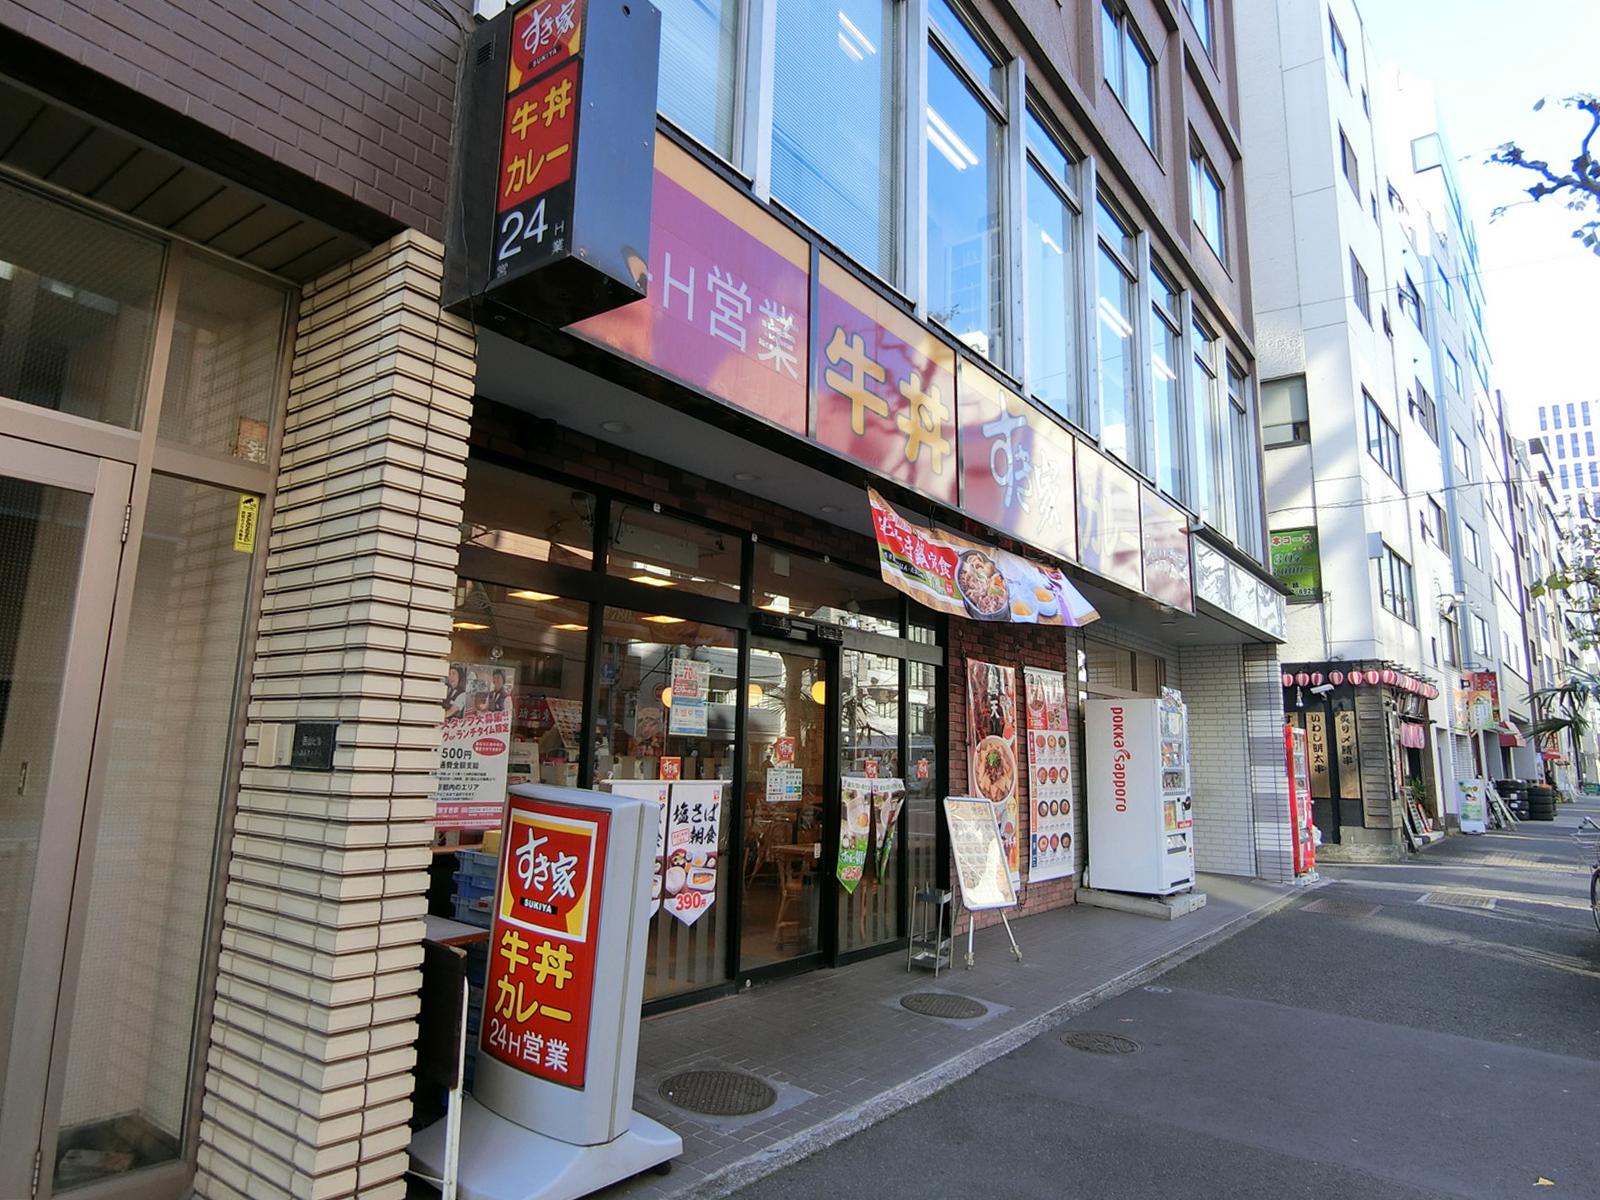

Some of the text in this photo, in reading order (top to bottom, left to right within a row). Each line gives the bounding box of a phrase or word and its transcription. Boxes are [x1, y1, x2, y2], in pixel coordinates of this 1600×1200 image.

[521, 0, 576, 55] すき家
[531, 48, 558, 68] SUKIYA
[510, 78, 573, 141] 牛丼
[503, 142, 570, 198] カレー
[824, 325, 952, 477] 牛丼
[982, 388, 1062, 536] すき家
[1310, 714, 1325, 774] いわし明太串
[688, 825, 717, 846] 朝食
[515, 827, 579, 902] すき家
[523, 898, 553, 914] SUKIYA
[675, 891, 706, 911] 390円
[500, 929, 574, 990] 牛丼
[494, 973, 573, 1024] カレー
[488, 1017, 570, 1074] 24H営業
